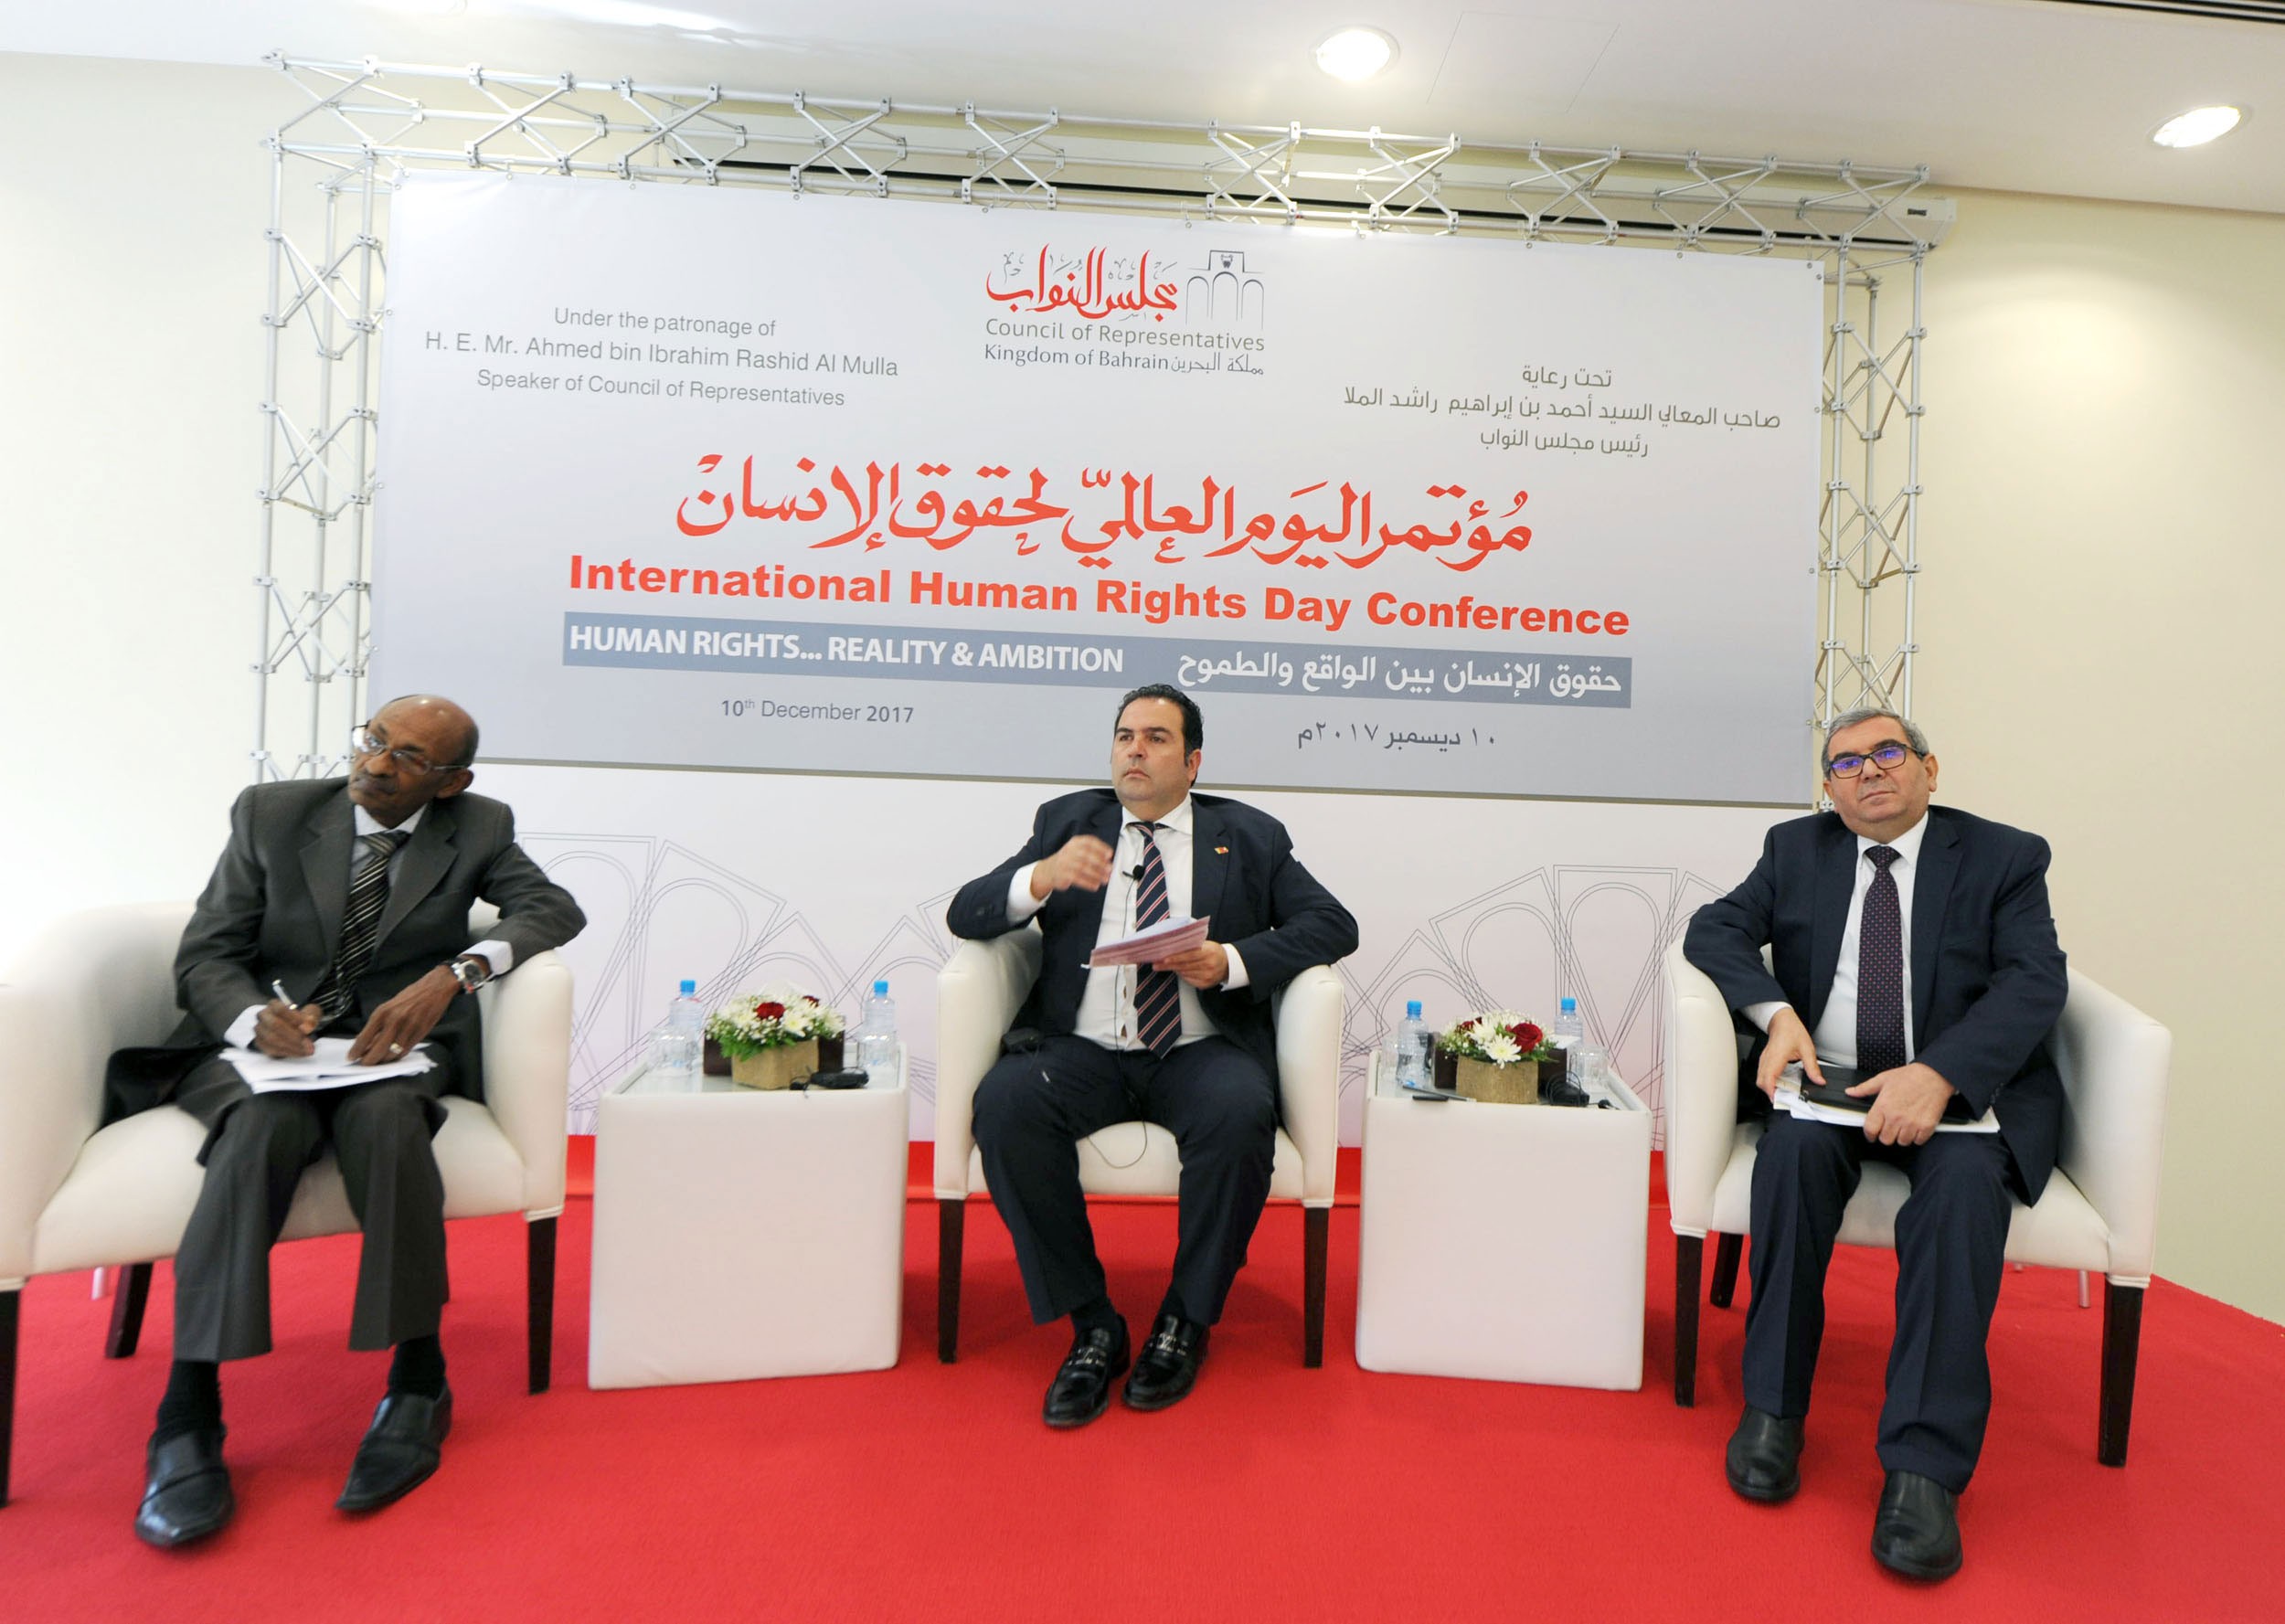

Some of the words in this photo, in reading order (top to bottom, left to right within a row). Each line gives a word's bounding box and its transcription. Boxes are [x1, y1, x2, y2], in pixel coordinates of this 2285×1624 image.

[984, 241, 1109, 314] النواب
[1076, 248, 1180, 324] مجلس
[554, 307, 614, 327] Under
[618, 311, 649, 329] the
[654, 315, 752, 339] patronage
[758, 320, 776, 337] of
[985, 318, 1065, 340] Council
[1071, 324, 1093, 341] of
[1099, 324, 1265, 353] Representatives
[425, 331, 448, 350] H.
[456, 332, 477, 352] E.
[484, 334, 518, 355] Mr.
[525, 336, 603, 359] Ahmed
[610, 341, 642, 362] bin
[649, 344, 729, 366] Ibrahim
[737, 348, 809, 371] Rashid
[814, 353, 836, 373] Al
[843, 355, 898, 377] Mulla
[984, 344, 1069, 367] Kingdom
[1074, 348, 1095, 366] of
[1099, 350, 1169, 370] Bahrain
[1170, 351, 1221, 375] البحرين
[1227, 353, 1264, 376] مملكة
[477, 368, 560, 391] Speaker
[565, 374, 584, 391] of
[588, 375, 660, 396] Council
[665, 379, 685, 398] of
[689, 380, 845, 407] Representatives
[1522, 365, 1568, 390] رعاية
[1574, 367, 1612, 387] تحت
[1344, 386, 1383, 407] الملا
[1389, 383, 1438, 414] راشد
[1449, 394, 1513, 419] إبراهيم
[1519, 396, 1540, 420] بن
[1546, 393, 1592, 419] أحمد
[1598, 403, 1653, 425] السيد
[1658, 404, 1717, 428] المعالي
[1723, 409, 1780, 431] صاحب
[1480, 428, 1529, 450] النواب
[1535, 431, 1595, 455] مجلس
[1600, 433, 1649, 458] رئيس
[569, 555, 891, 603] International
[909, 570, 1078, 611] Human
[1096, 578, 1247, 624] Rights
[1264, 587, 1352, 632] Day
[1366, 591, 1630, 636] Conference
[569, 624, 687, 655] HUMAN
[692, 630, 824, 662] RIGHTS...
[827, 635, 949, 666] REALITY
[950, 641, 975, 667] &
[976, 642, 1124, 674] AMBITION
[1176, 649, 1294, 688] والطموح
[1301, 653, 1377, 693] الواقع
[1384, 659, 1436, 695] بين
[1442, 659, 1542, 699] الإنسان
[1548, 663, 1622, 700] حقوق
[761, 699, 862, 721] December
[866, 705, 914, 724] 2017
[1383, 731, 1461, 753] ديسمبر
